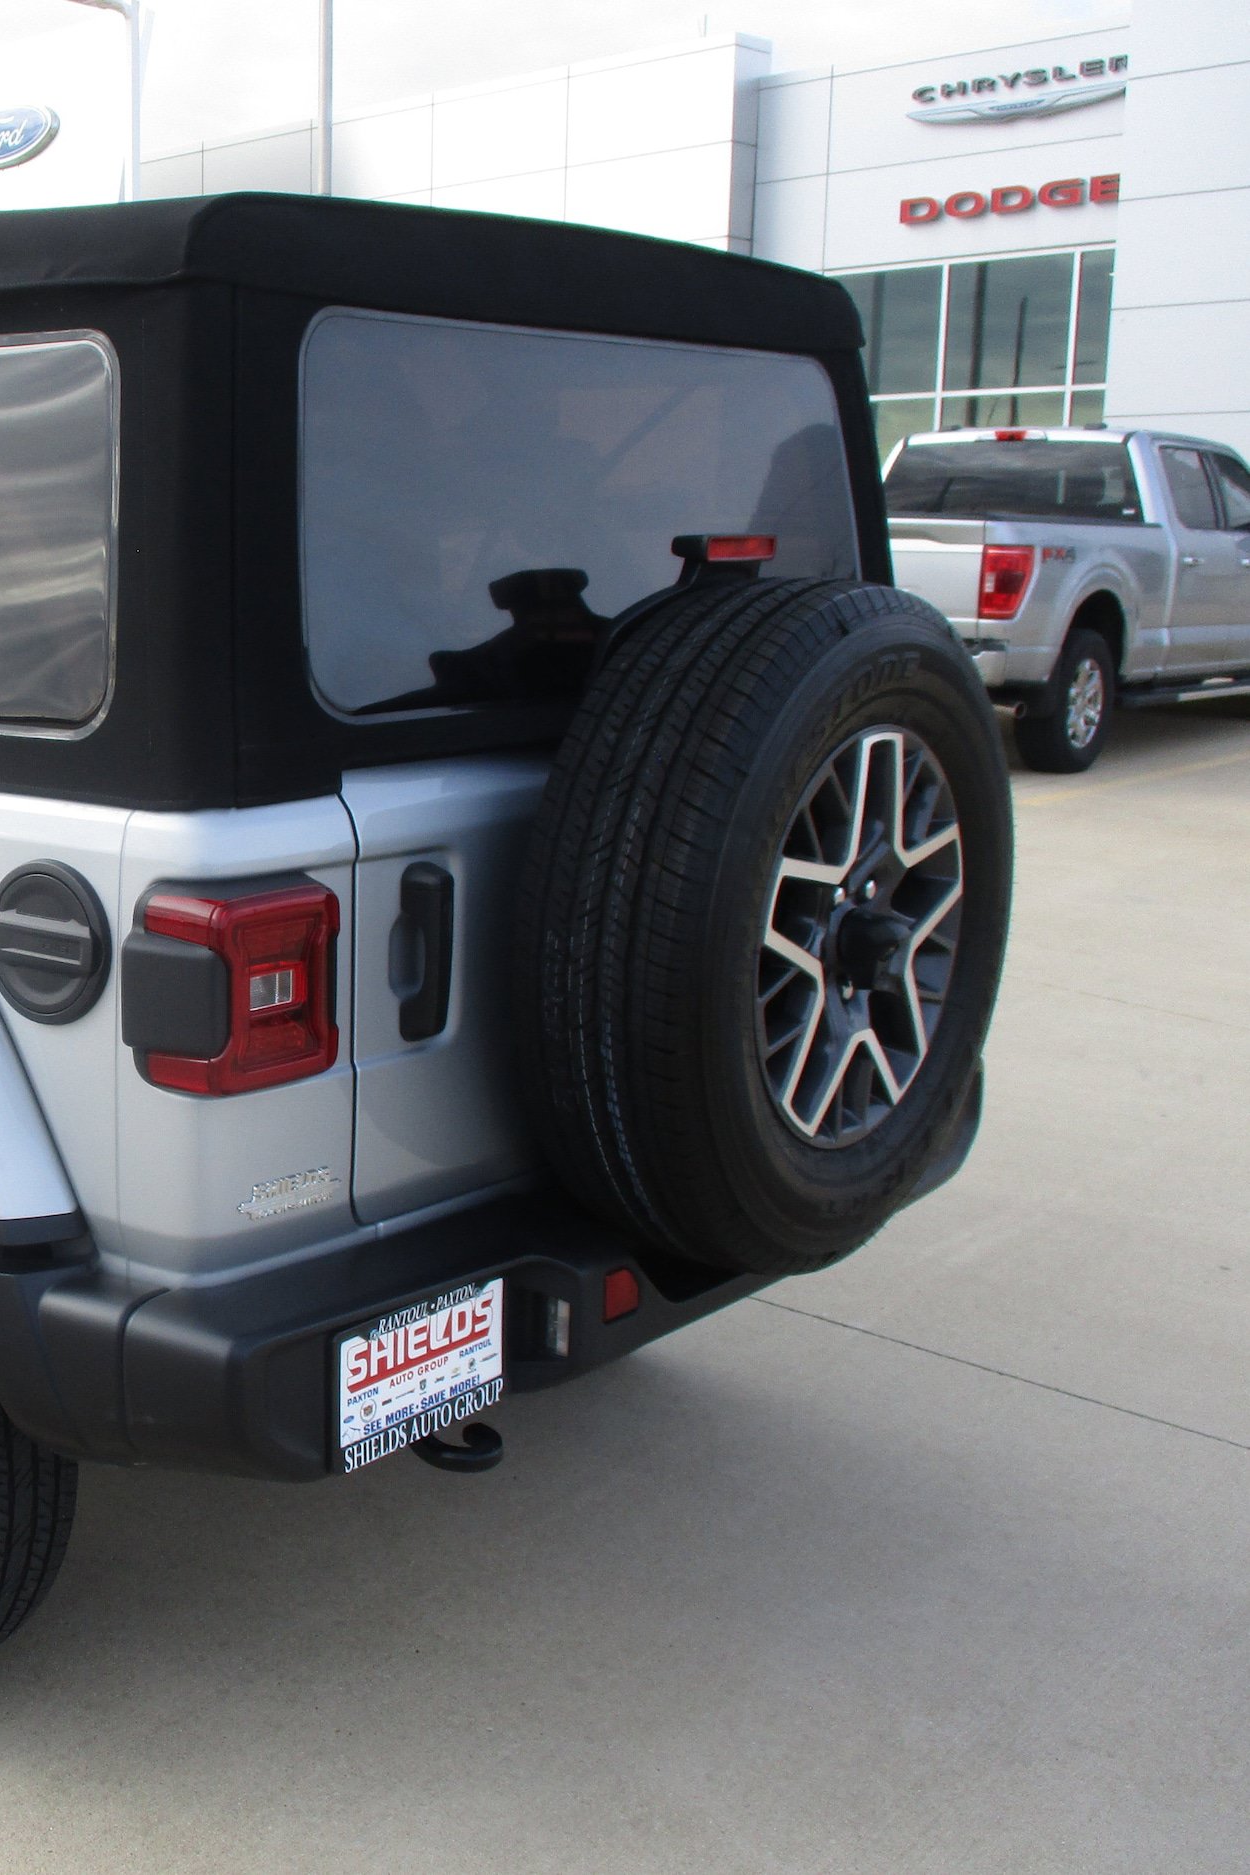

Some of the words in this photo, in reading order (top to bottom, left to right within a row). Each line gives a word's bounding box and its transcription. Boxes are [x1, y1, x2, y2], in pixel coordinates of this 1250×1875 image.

[912, 54, 1128, 103] CHRYSLER
[900, 173, 1120, 224] DODGE
[377, 1302, 429, 1334] RANTOUL
[434, 1282, 476, 1311] PAXTON
[346, 1291, 495, 1392] SHIELDS
[459, 1338, 492, 1359] RANTOUL
[347, 1386, 379, 1407] PAXTON
[389, 1371, 414, 1388] AUTO
[417, 1356, 449, 1381] GROUP
[344, 1424, 408, 1474] SHIELDS
[410, 1403, 453, 1442] AUTO
[454, 1378, 504, 1421] GROUP
[363, 1417, 382, 1436] SEE
[385, 1403, 415, 1426] MORE
[449, 1374, 480, 1399] MORE!
